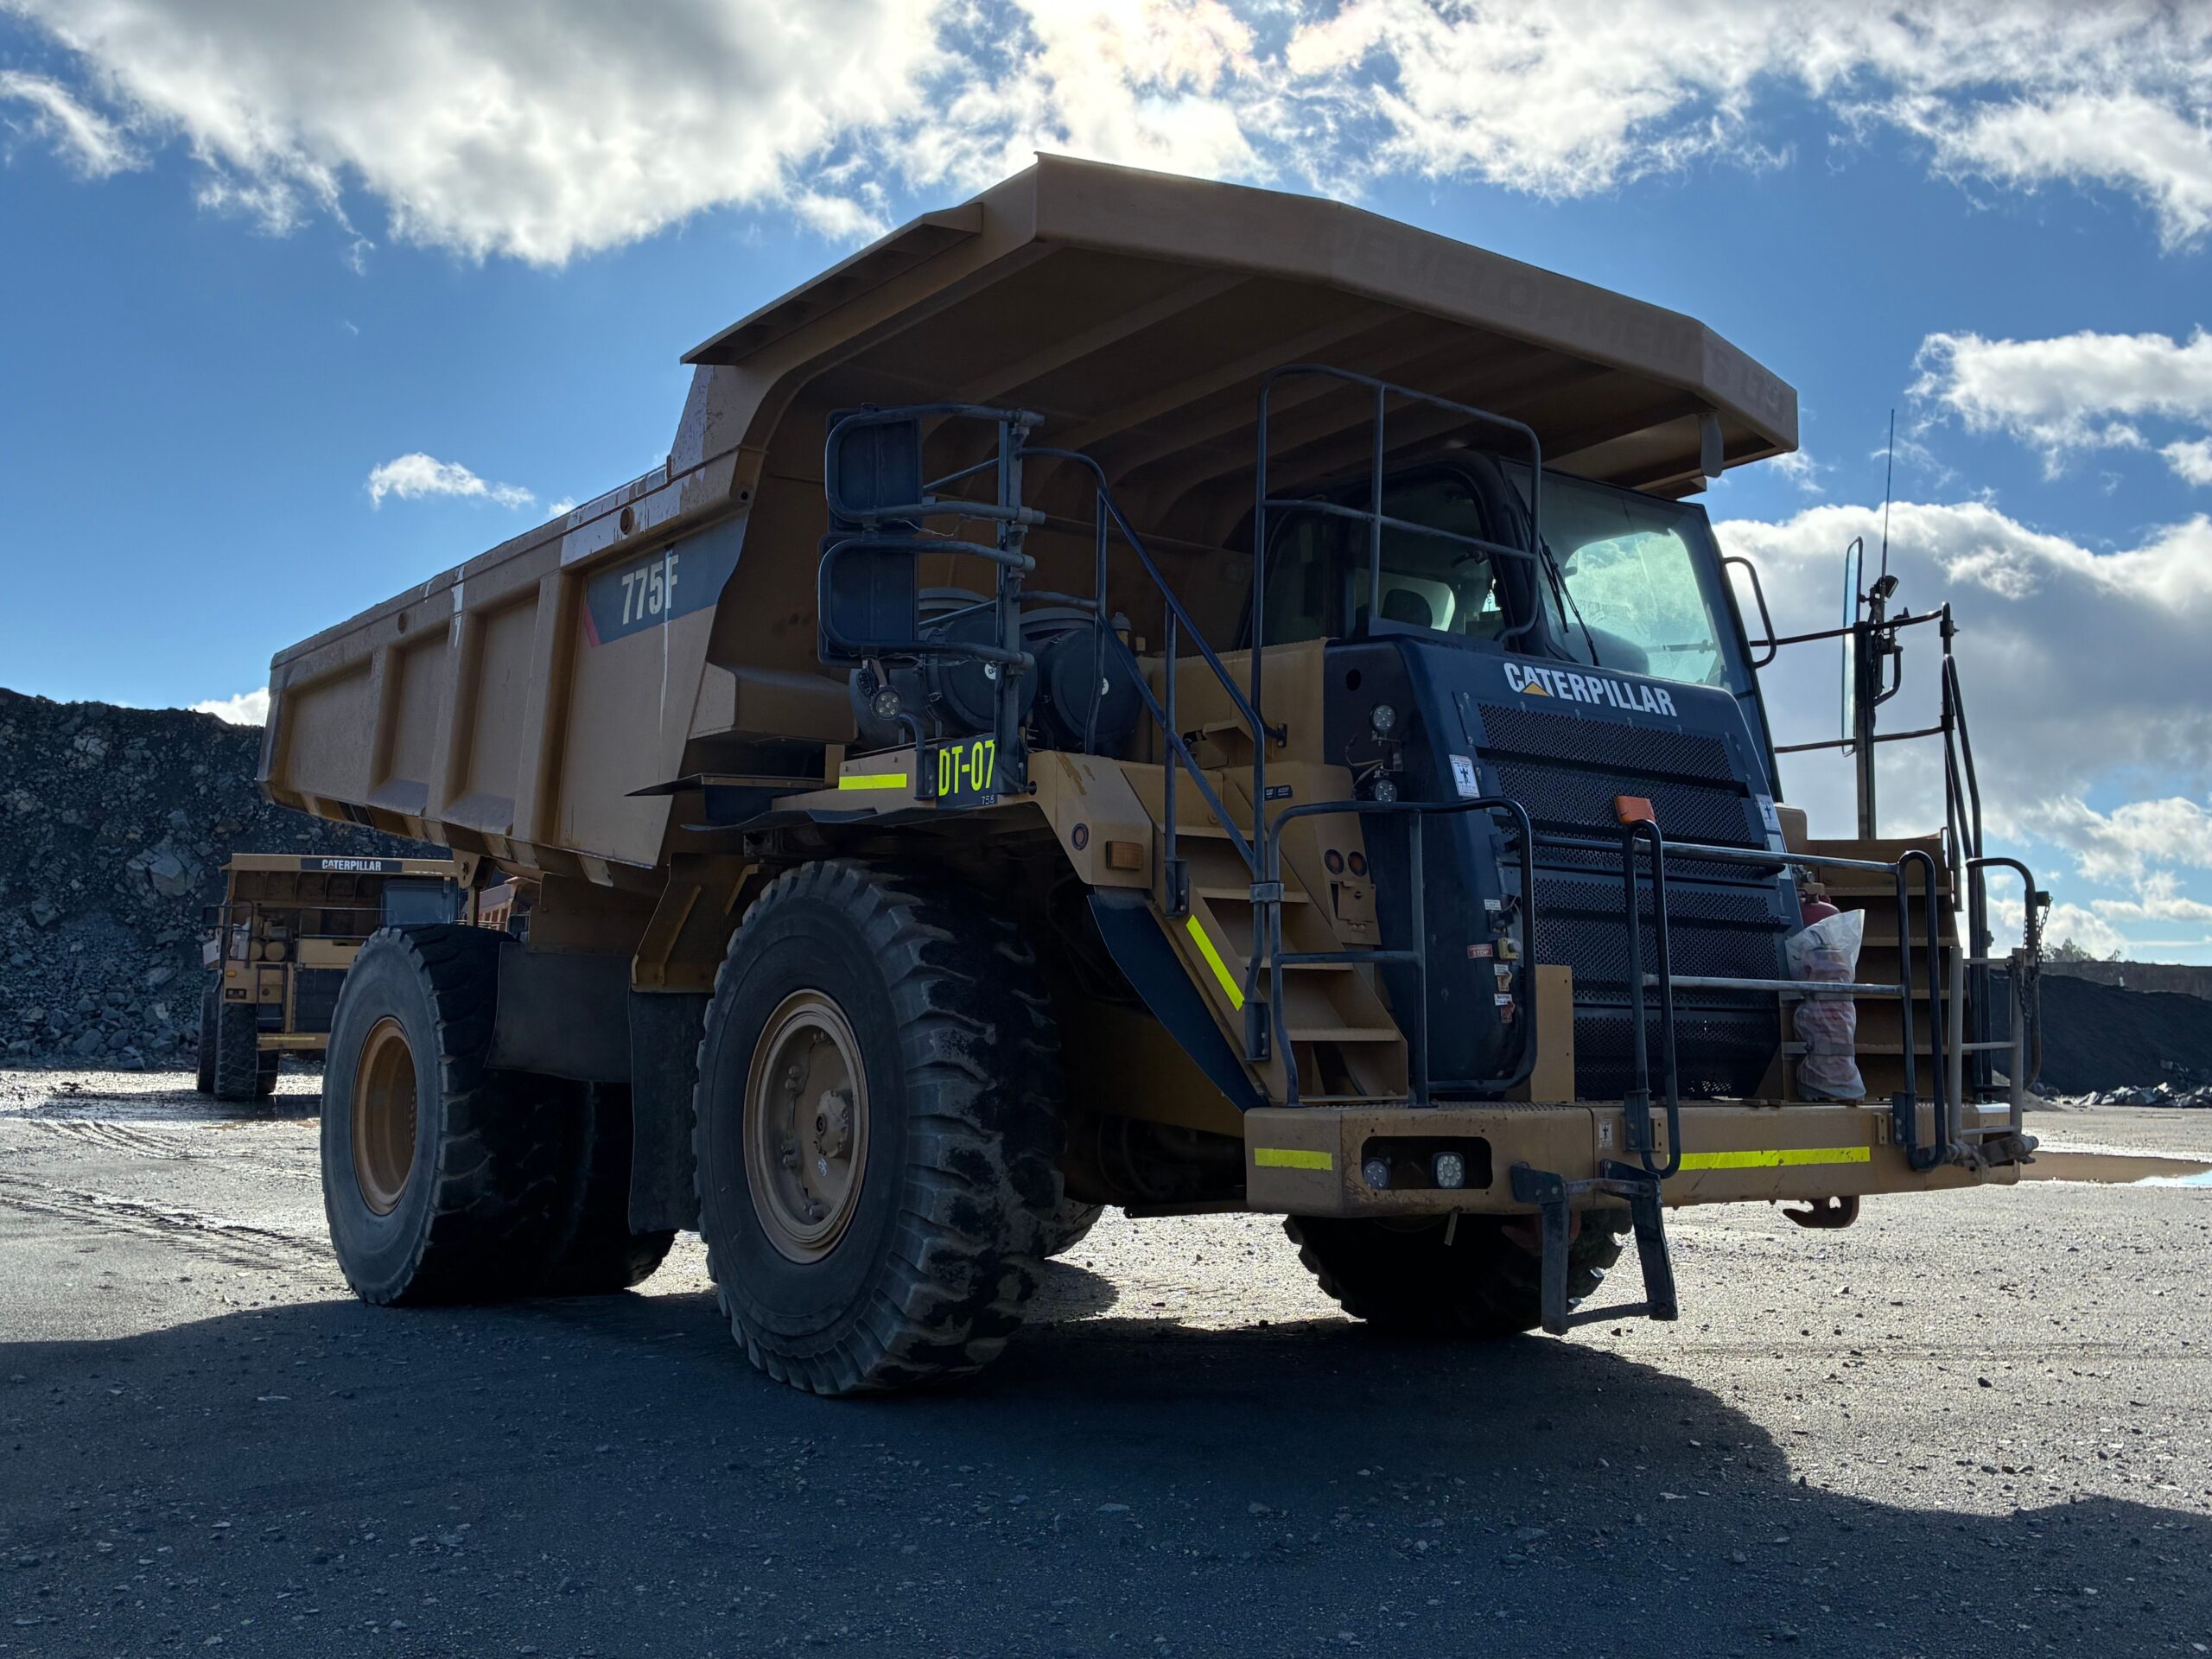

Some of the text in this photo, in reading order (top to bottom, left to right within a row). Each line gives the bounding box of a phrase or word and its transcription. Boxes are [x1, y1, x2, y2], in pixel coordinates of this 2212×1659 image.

[621, 554, 679, 626] 775F
[1503, 662, 1678, 717] CATERPILLAR
[938, 739, 995, 797] DT-07
[321, 859, 382, 872] CATERPILLAR
